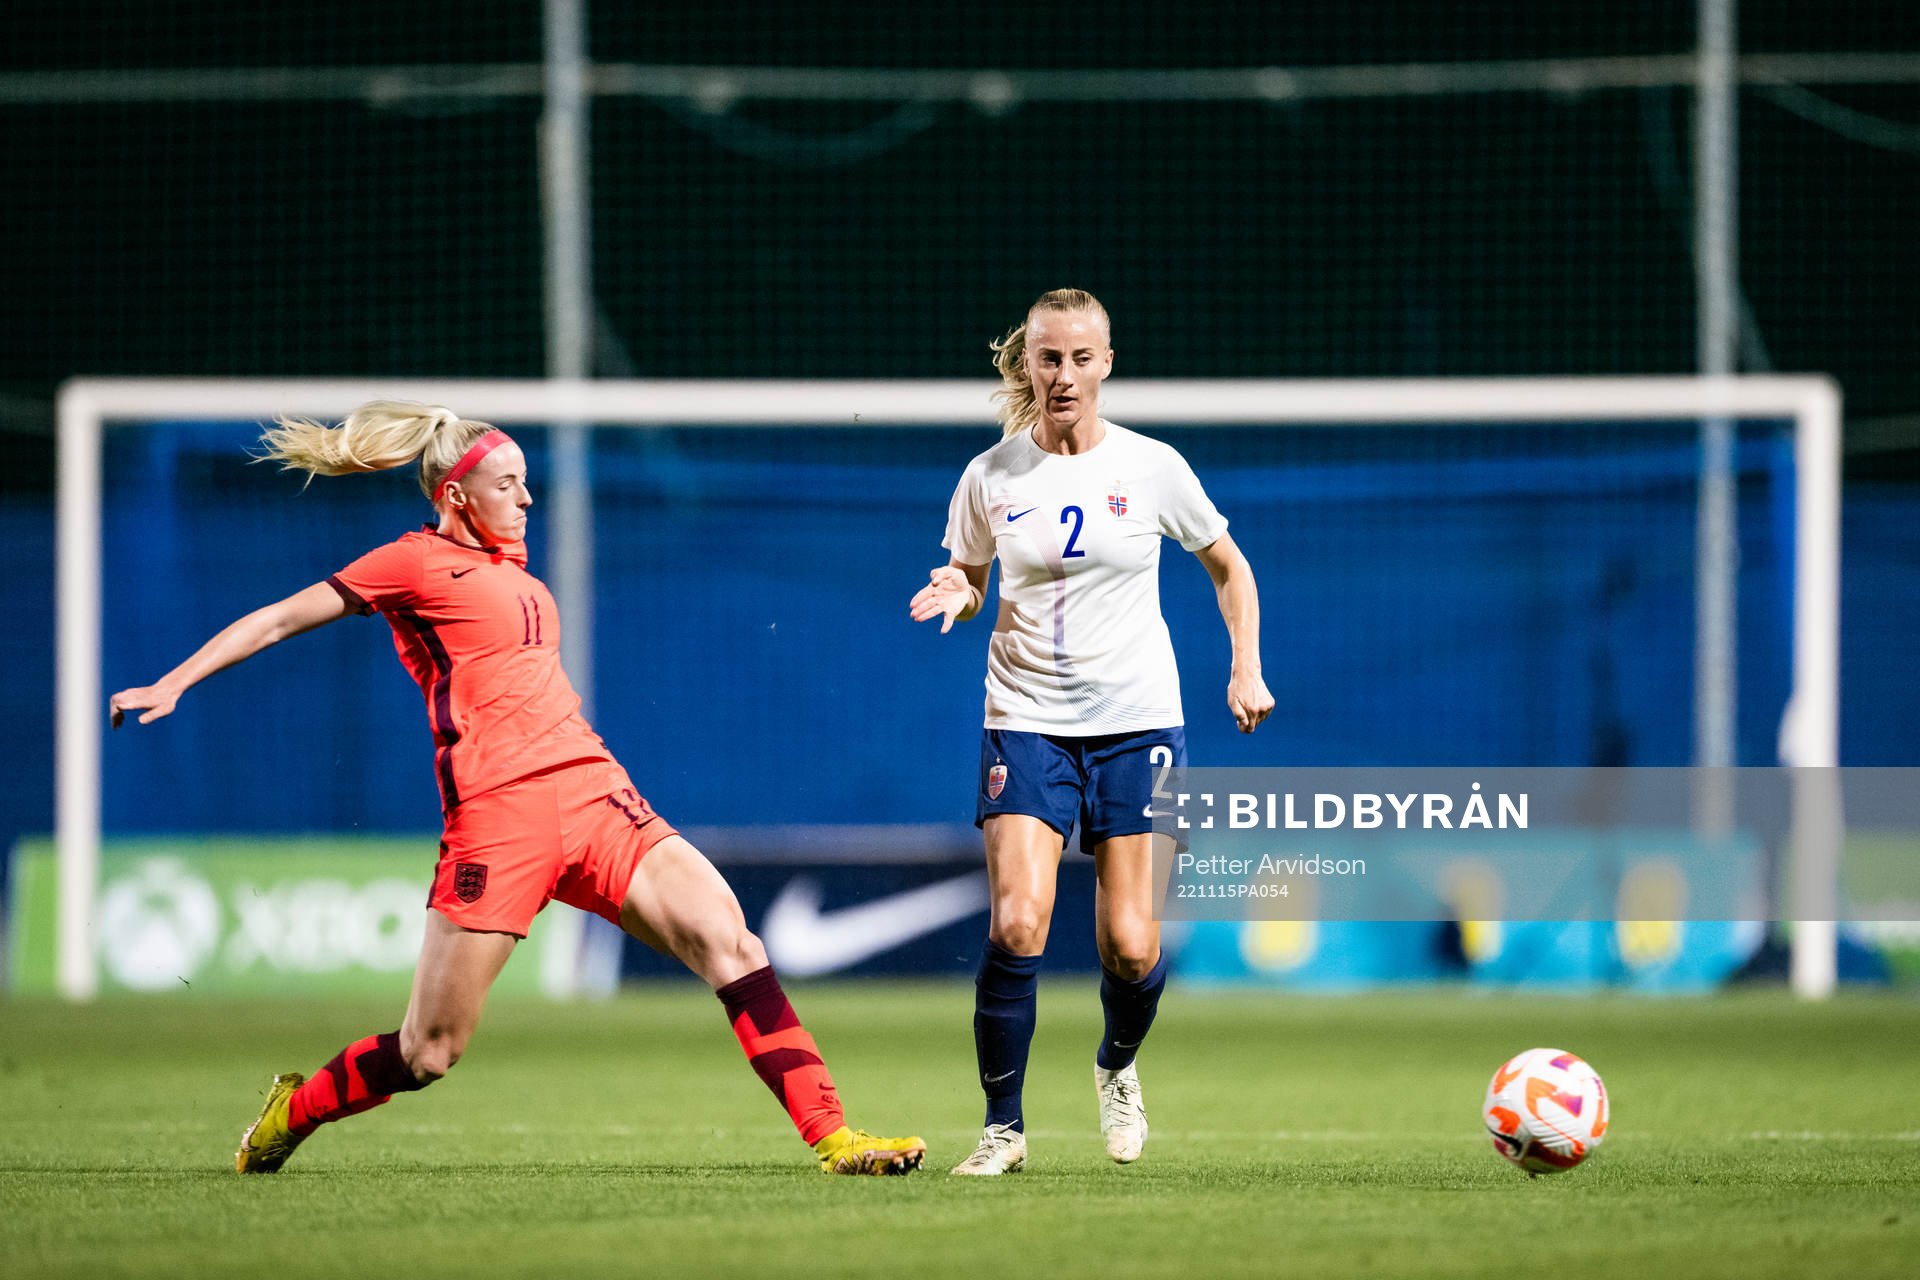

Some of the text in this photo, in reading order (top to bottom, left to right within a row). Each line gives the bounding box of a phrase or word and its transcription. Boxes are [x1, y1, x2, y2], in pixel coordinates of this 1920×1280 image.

[1060, 505, 1086, 558] 2
[517, 593, 543, 646] 11
[1149, 745, 1173, 799] 2
[227, 878, 426, 970] XBO
